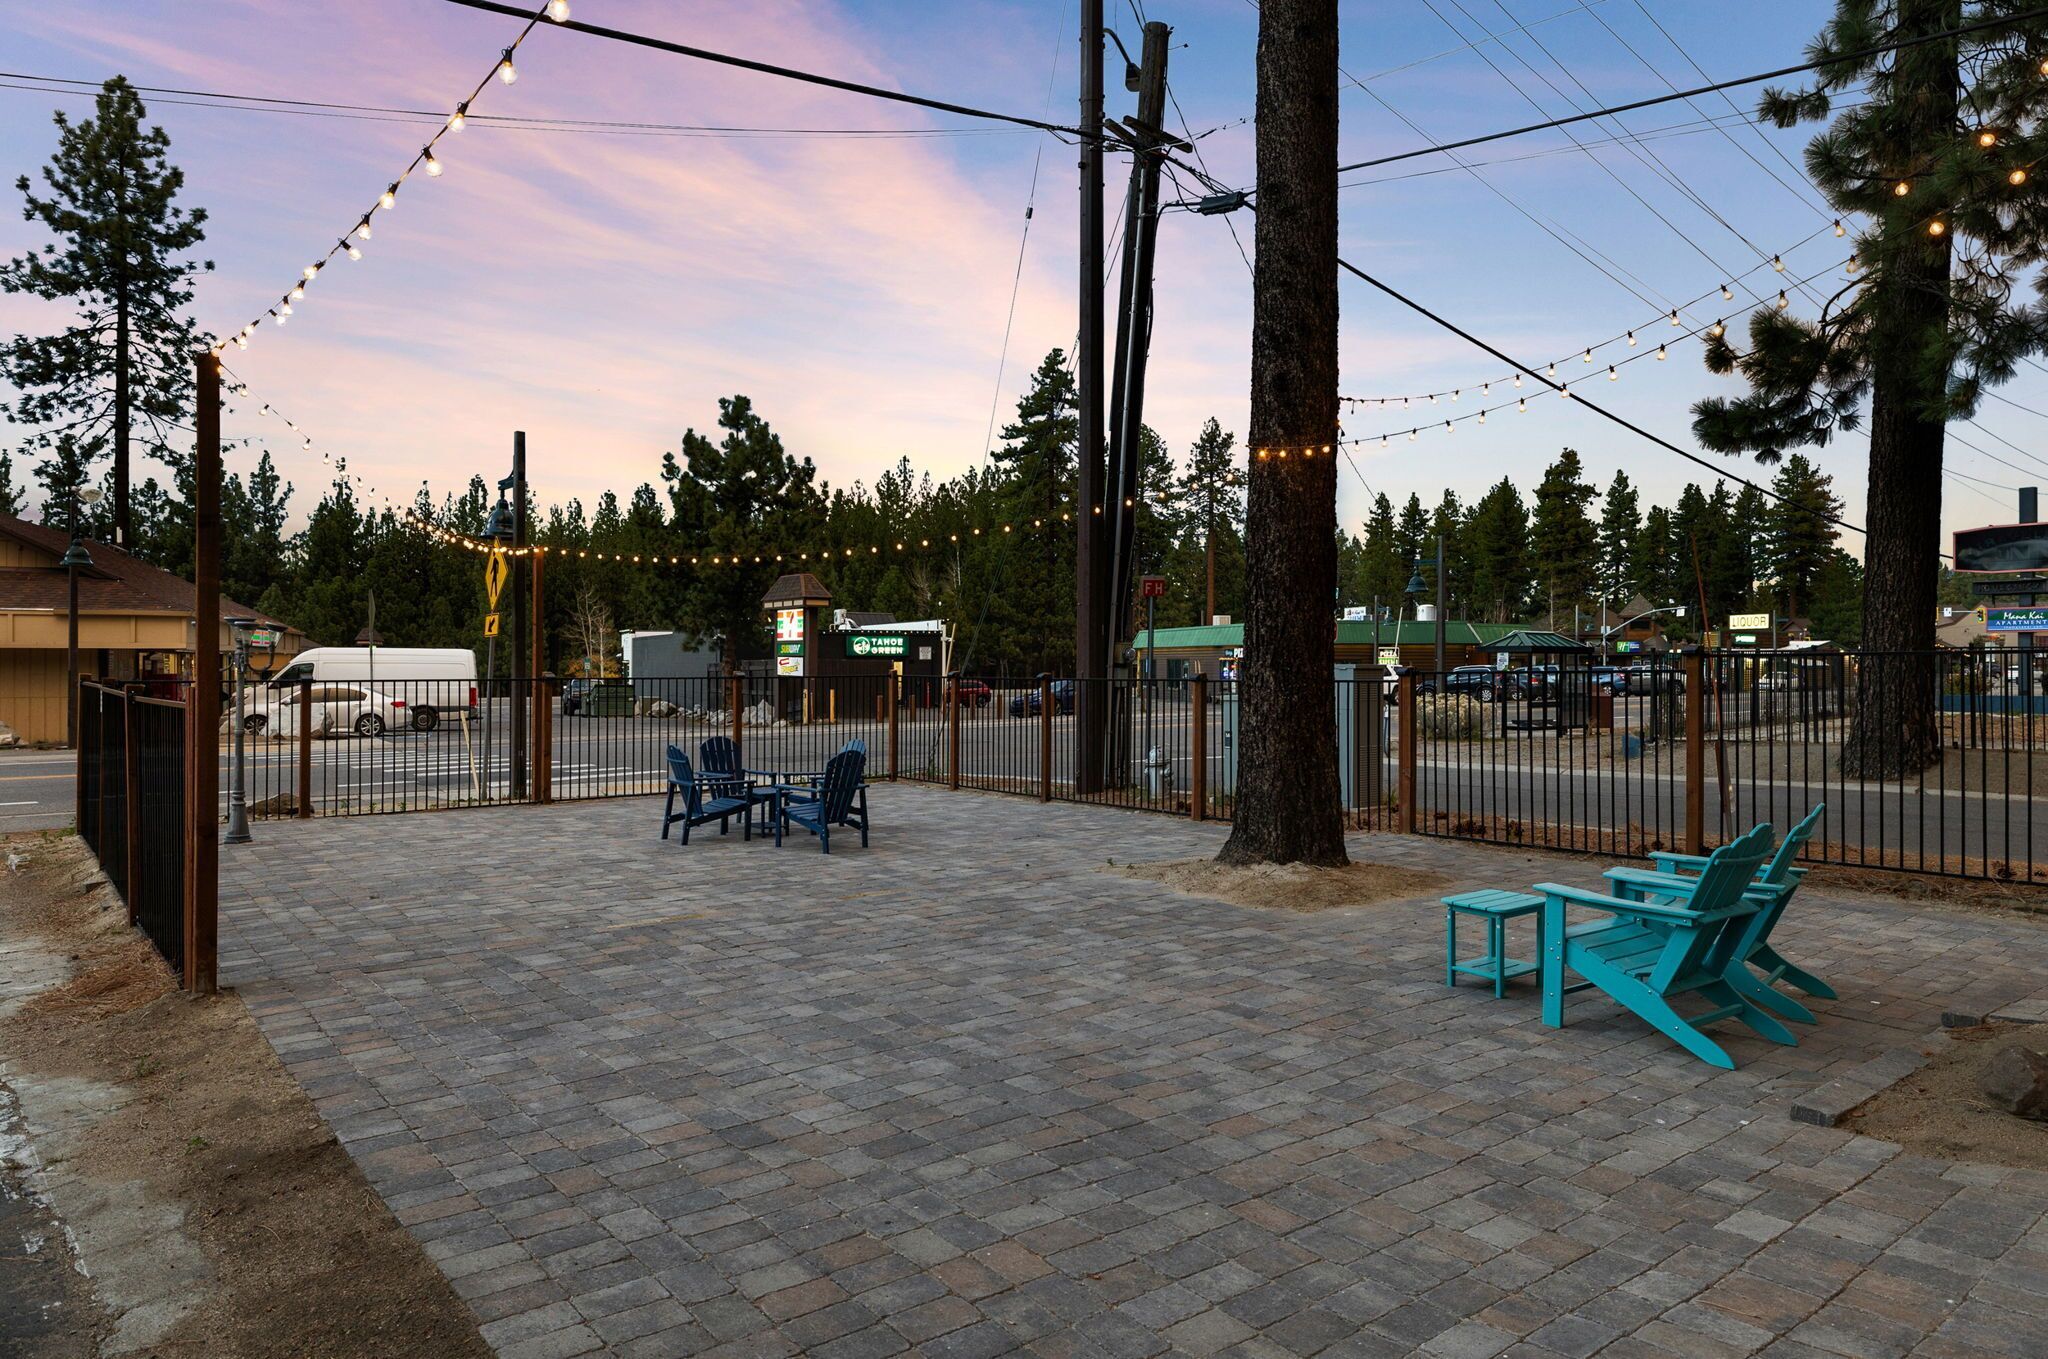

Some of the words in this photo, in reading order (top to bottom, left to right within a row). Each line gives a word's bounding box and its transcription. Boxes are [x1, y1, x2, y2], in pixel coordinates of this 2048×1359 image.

[2003, 611, 2027, 620] Mana
[2029, 611, 2044, 620] Kai
[1732, 616, 1766, 627] LIQUOR
[871, 638, 903, 646] TAHOE
